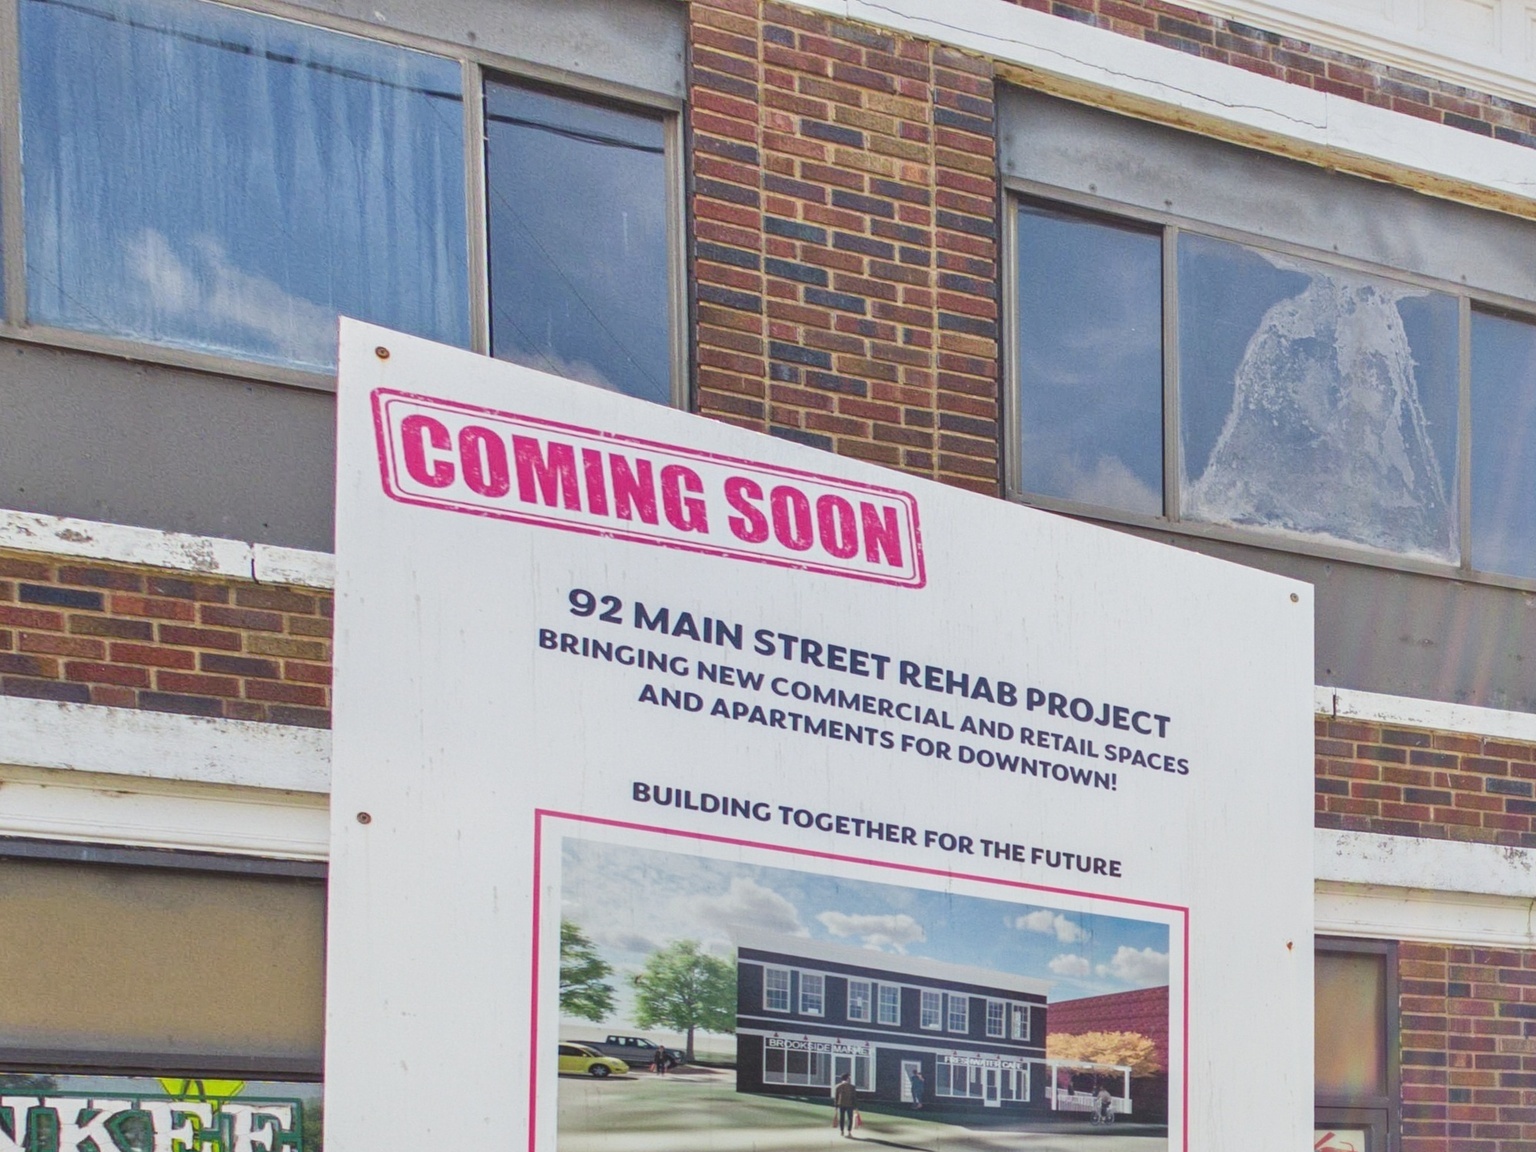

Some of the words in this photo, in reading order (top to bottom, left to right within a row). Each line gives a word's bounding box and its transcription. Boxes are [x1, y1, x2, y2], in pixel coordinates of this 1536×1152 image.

[402, 415, 708, 533] COMING
[724, 476, 902, 567] SOON
[539, 629, 688, 676] BRINGING
[698, 661, 764, 691] NEW
[771, 678, 954, 730] COMMERCIAL
[960, 716, 1014, 740] AND
[1021, 727, 1099, 758] RETAIL
[1105, 744, 1189, 775] SPACES
[569, 589, 622, 624] 92
[634, 602, 742, 650] MAIN
[754, 629, 890, 680] STREET
[900, 660, 1017, 706] REHAB
[1027, 688, 1170, 738] PROJECT
[638, 684, 703, 712] AND
[710, 698, 894, 749] APARTMENTS
[902, 734, 952, 760] FOR
[959, 746, 1117, 791] DOWNTOWN!
[633, 782, 771, 821] BUILDING
[778, 806, 917, 845] TOGETHER
[925, 830, 974, 854] FOR
[980, 839, 1025, 862] THE
[1032, 847, 1121, 877] FUTURE
[769, 1038, 831, 1052] BROOKSIDE
